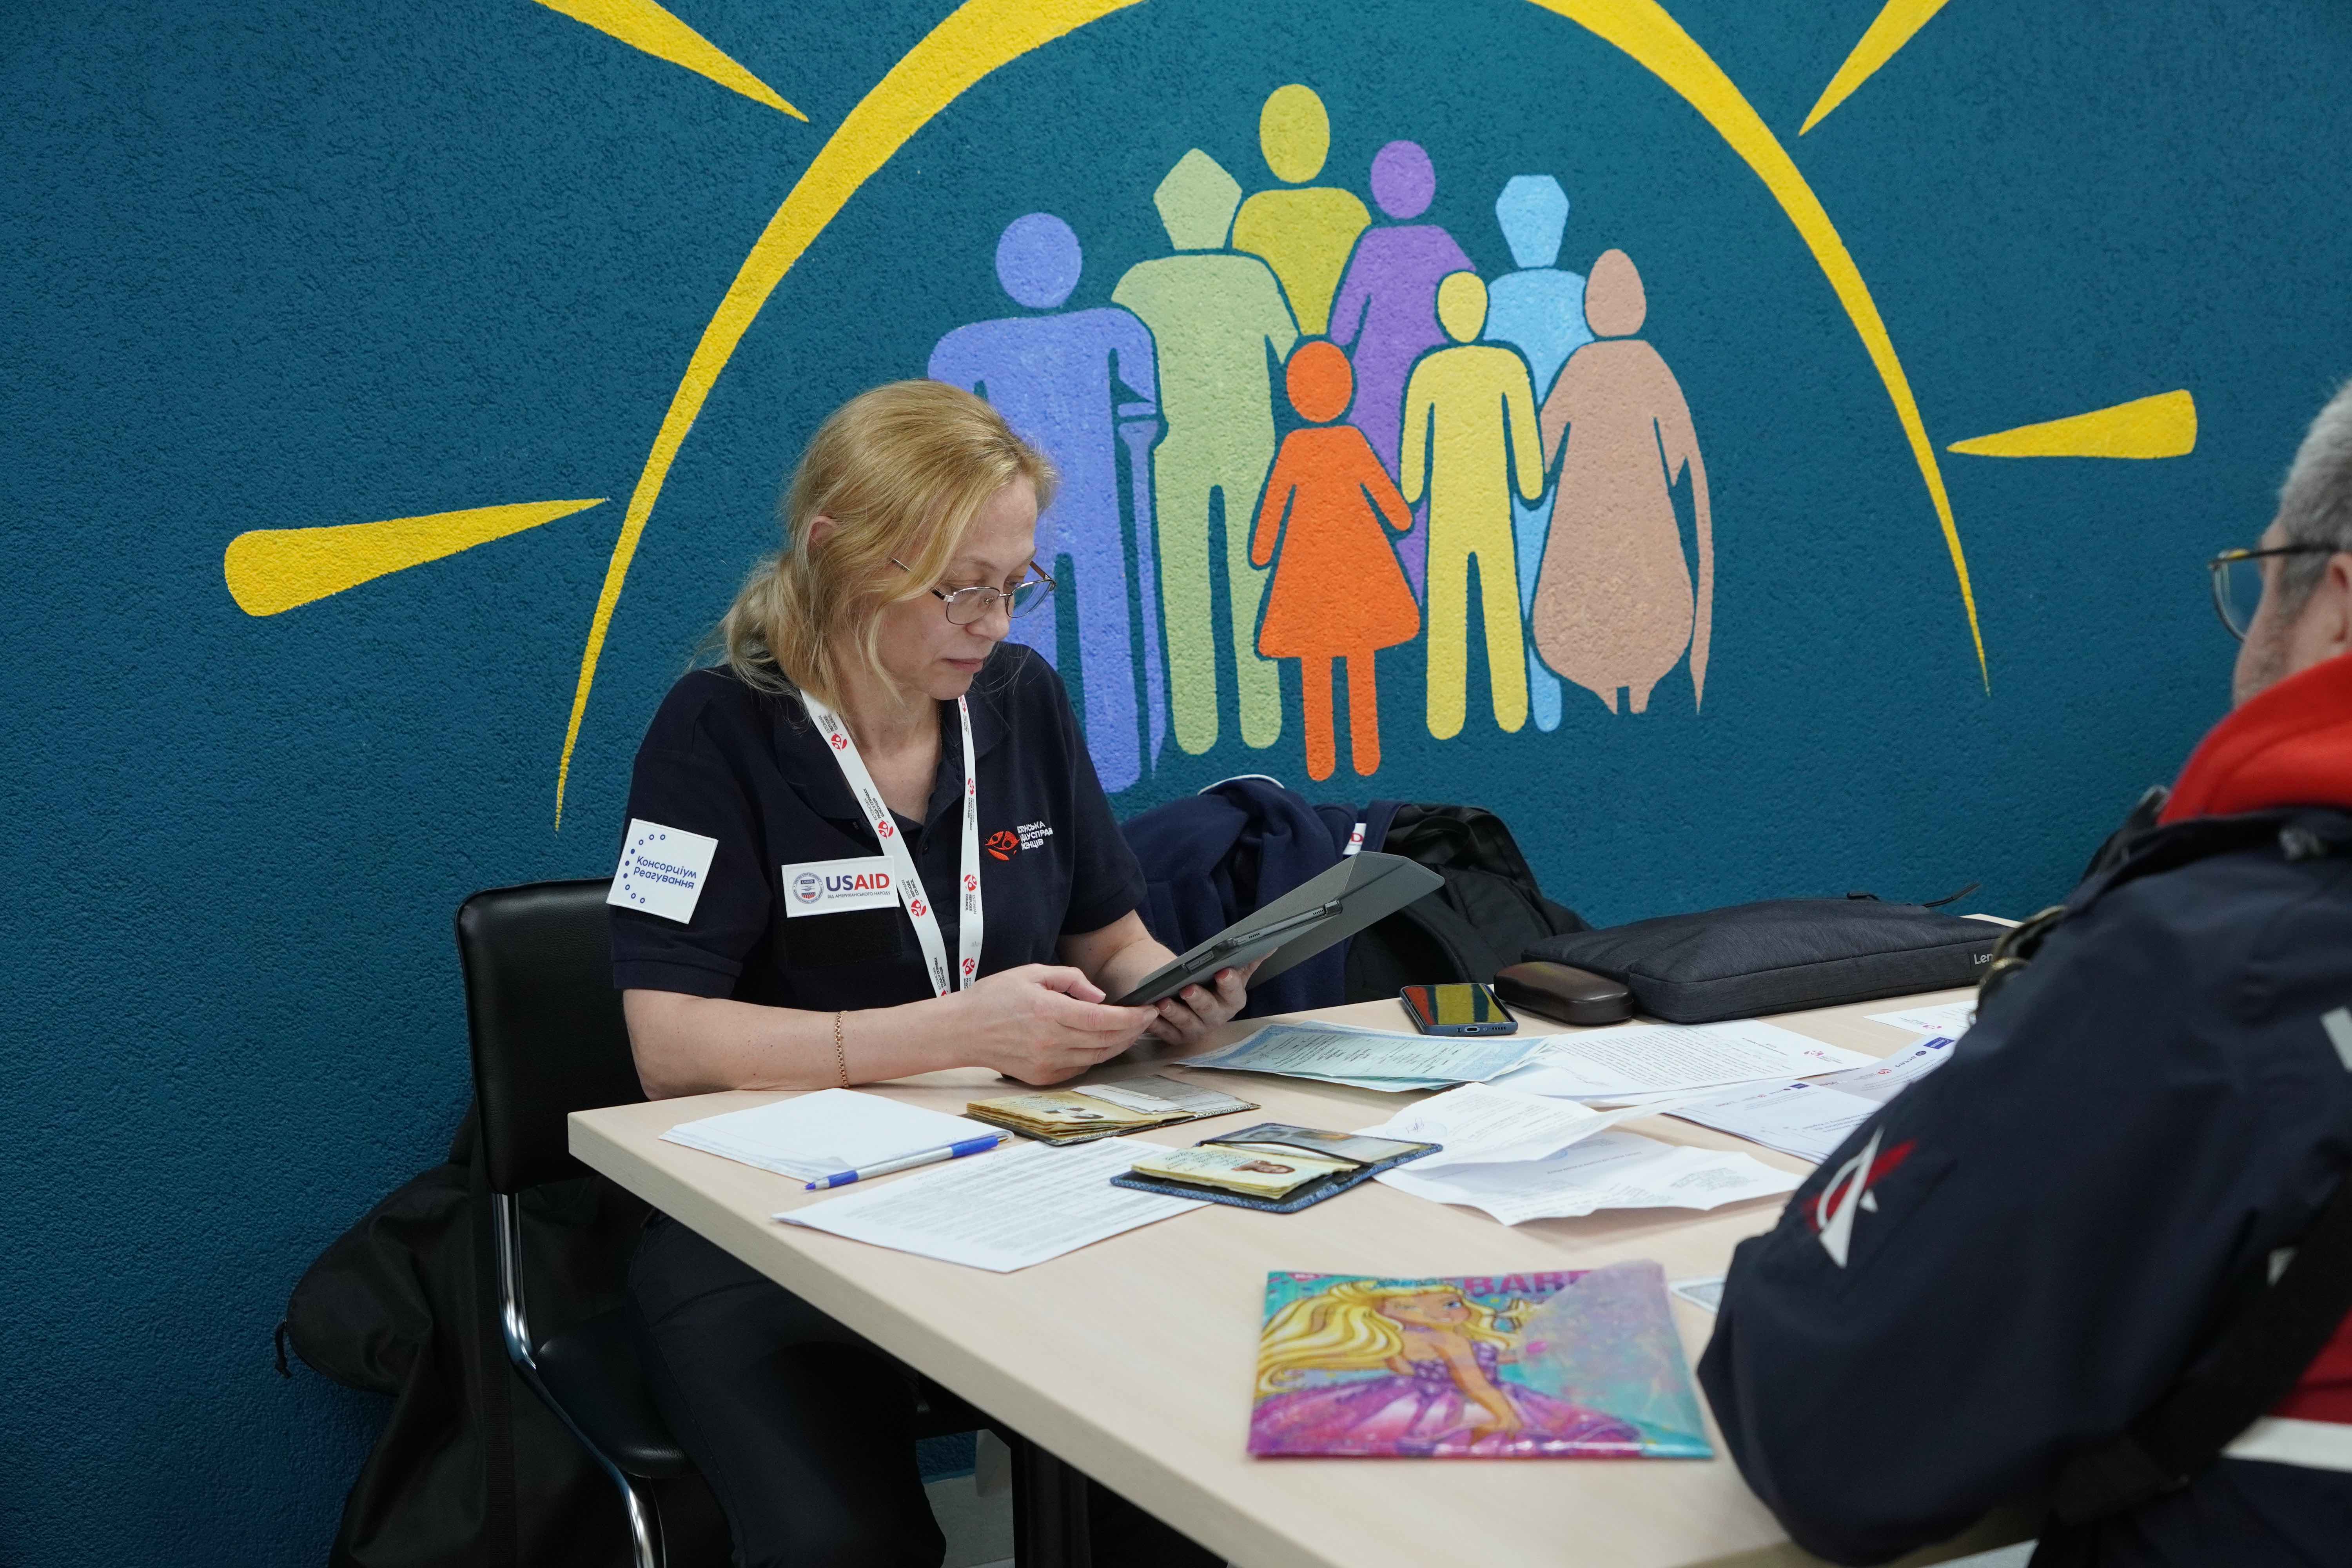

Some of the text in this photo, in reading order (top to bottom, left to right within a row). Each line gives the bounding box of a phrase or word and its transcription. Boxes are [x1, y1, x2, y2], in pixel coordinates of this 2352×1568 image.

[637, 856, 697, 879] Консорціум
[633, 867, 694, 889] Реагування
[826, 873, 890, 891] USAID
[911, 878, 919, 895] COUNCIL
[901, 879, 912, 898] ESTONIAN
[906, 880, 915, 897] REFUGEE
[1894, 1056, 1916, 1068] acted
